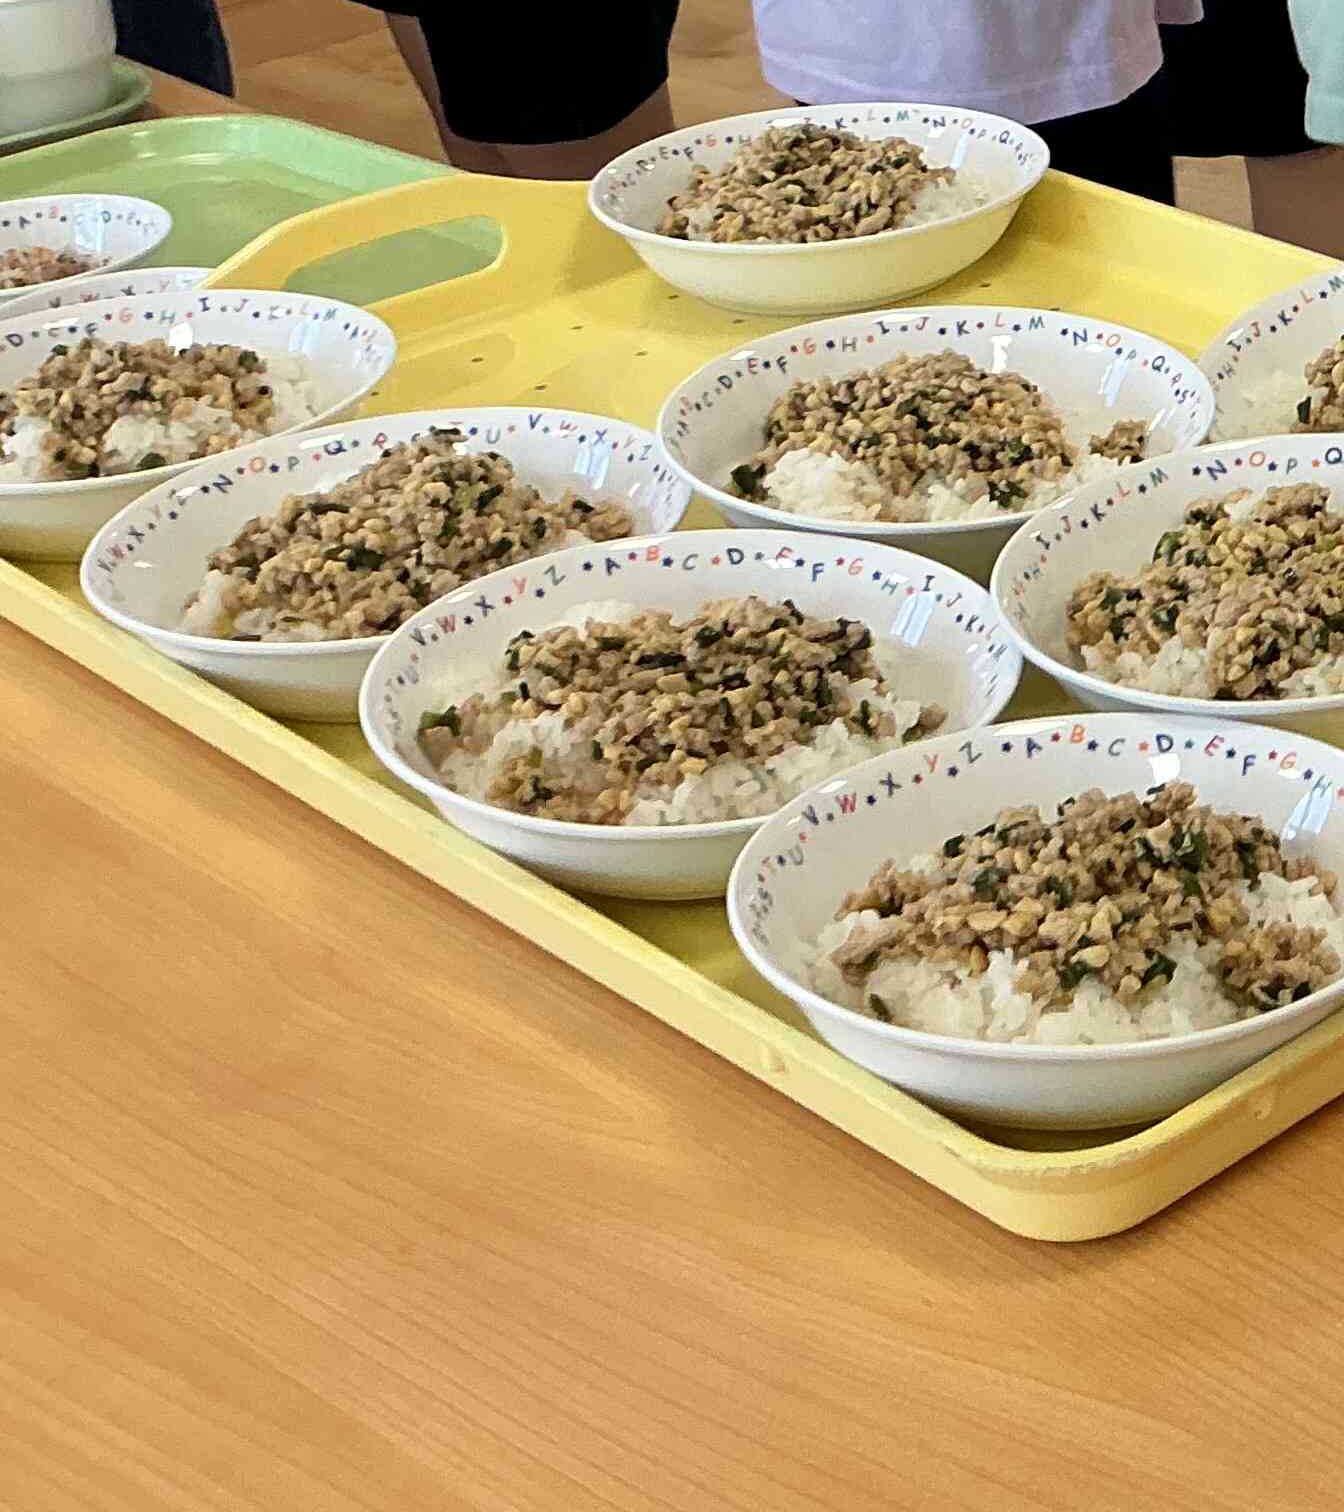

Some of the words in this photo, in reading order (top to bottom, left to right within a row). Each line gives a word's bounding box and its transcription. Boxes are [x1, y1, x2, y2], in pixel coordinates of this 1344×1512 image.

[683, 147, 693, 160] F
[835, 118, 846, 130] K
[933, 117, 946, 128] N
[999, 130, 1013, 144] Q
[5, 334, 23, 347] D
[85, 323, 97, 337] F
[159, 311, 175, 325] H
[199, 297, 210, 312] I
[234, 298, 248, 312] J
[718, 375, 732, 389] D
[747, 358, 758, 375] E
[776, 356, 787, 374] F
[803, 338, 816, 355] G
[842, 337, 856, 352] H
[876, 321, 890, 334] I
[916, 317, 929, 331] J
[957, 320, 969, 336] K
[994, 313, 1005, 328] L
[1029, 316, 1045, 330] M
[1073, 329, 1087, 345] N
[1105, 334, 1121, 348] O
[1152, 356, 1165, 372] Q
[1227, 340, 1241, 352] I
[1251, 322, 1260, 338] J
[1278, 310, 1293, 326] K
[1300, 290, 1315, 304] L
[1328, 276, 1344, 292] M
[128, 526, 145, 543] X
[213, 474, 233, 493] N
[248, 457, 266, 473] O
[288, 456, 300, 471] P
[324, 441, 347, 455] Q
[372, 433, 387, 449] R
[486, 429, 500, 444] U
[528, 414, 542, 429] V
[560, 420, 577, 432] W
[594, 430, 607, 445] X
[1036, 535, 1050, 550] I
[1061, 515, 1071, 533] J
[1091, 504, 1105, 521] K
[1116, 482, 1131, 498] L
[1150, 468, 1168, 487] M
[1206, 460, 1227, 480] N
[1249, 451, 1266, 467] O
[1286, 458, 1298, 474] P
[1325, 448, 1342, 464] Q
[410, 628, 426, 646] V
[437, 615, 455, 633] W
[475, 596, 494, 616] X
[512, 578, 526, 595] Y
[544, 565, 566, 586] Z
[605, 558, 620, 575] A
[646, 545, 660, 561] B
[682, 554, 698, 570] C
[726, 548, 744, 565] D
[812, 563, 824, 582] F
[848, 558, 864, 575] G
[881, 579, 899, 595] H
[922, 575, 935, 591] I
[946, 592, 962, 608] J
[966, 615, 980, 632] K
[802, 806, 819, 825] V
[836, 793, 856, 814] W
[880, 773, 901, 797] X
[923, 754, 938, 773] Y
[959, 742, 982, 764] Z
[1026, 738, 1042, 758] A
[1070, 724, 1084, 744] B
[1108, 738, 1125, 756] C
[1156, 734, 1173, 753] D
[1204, 735, 1224, 756] E
[1242, 755, 1256, 776] F
[1280, 752, 1296, 769] G
[1311, 775, 1333, 797] H
